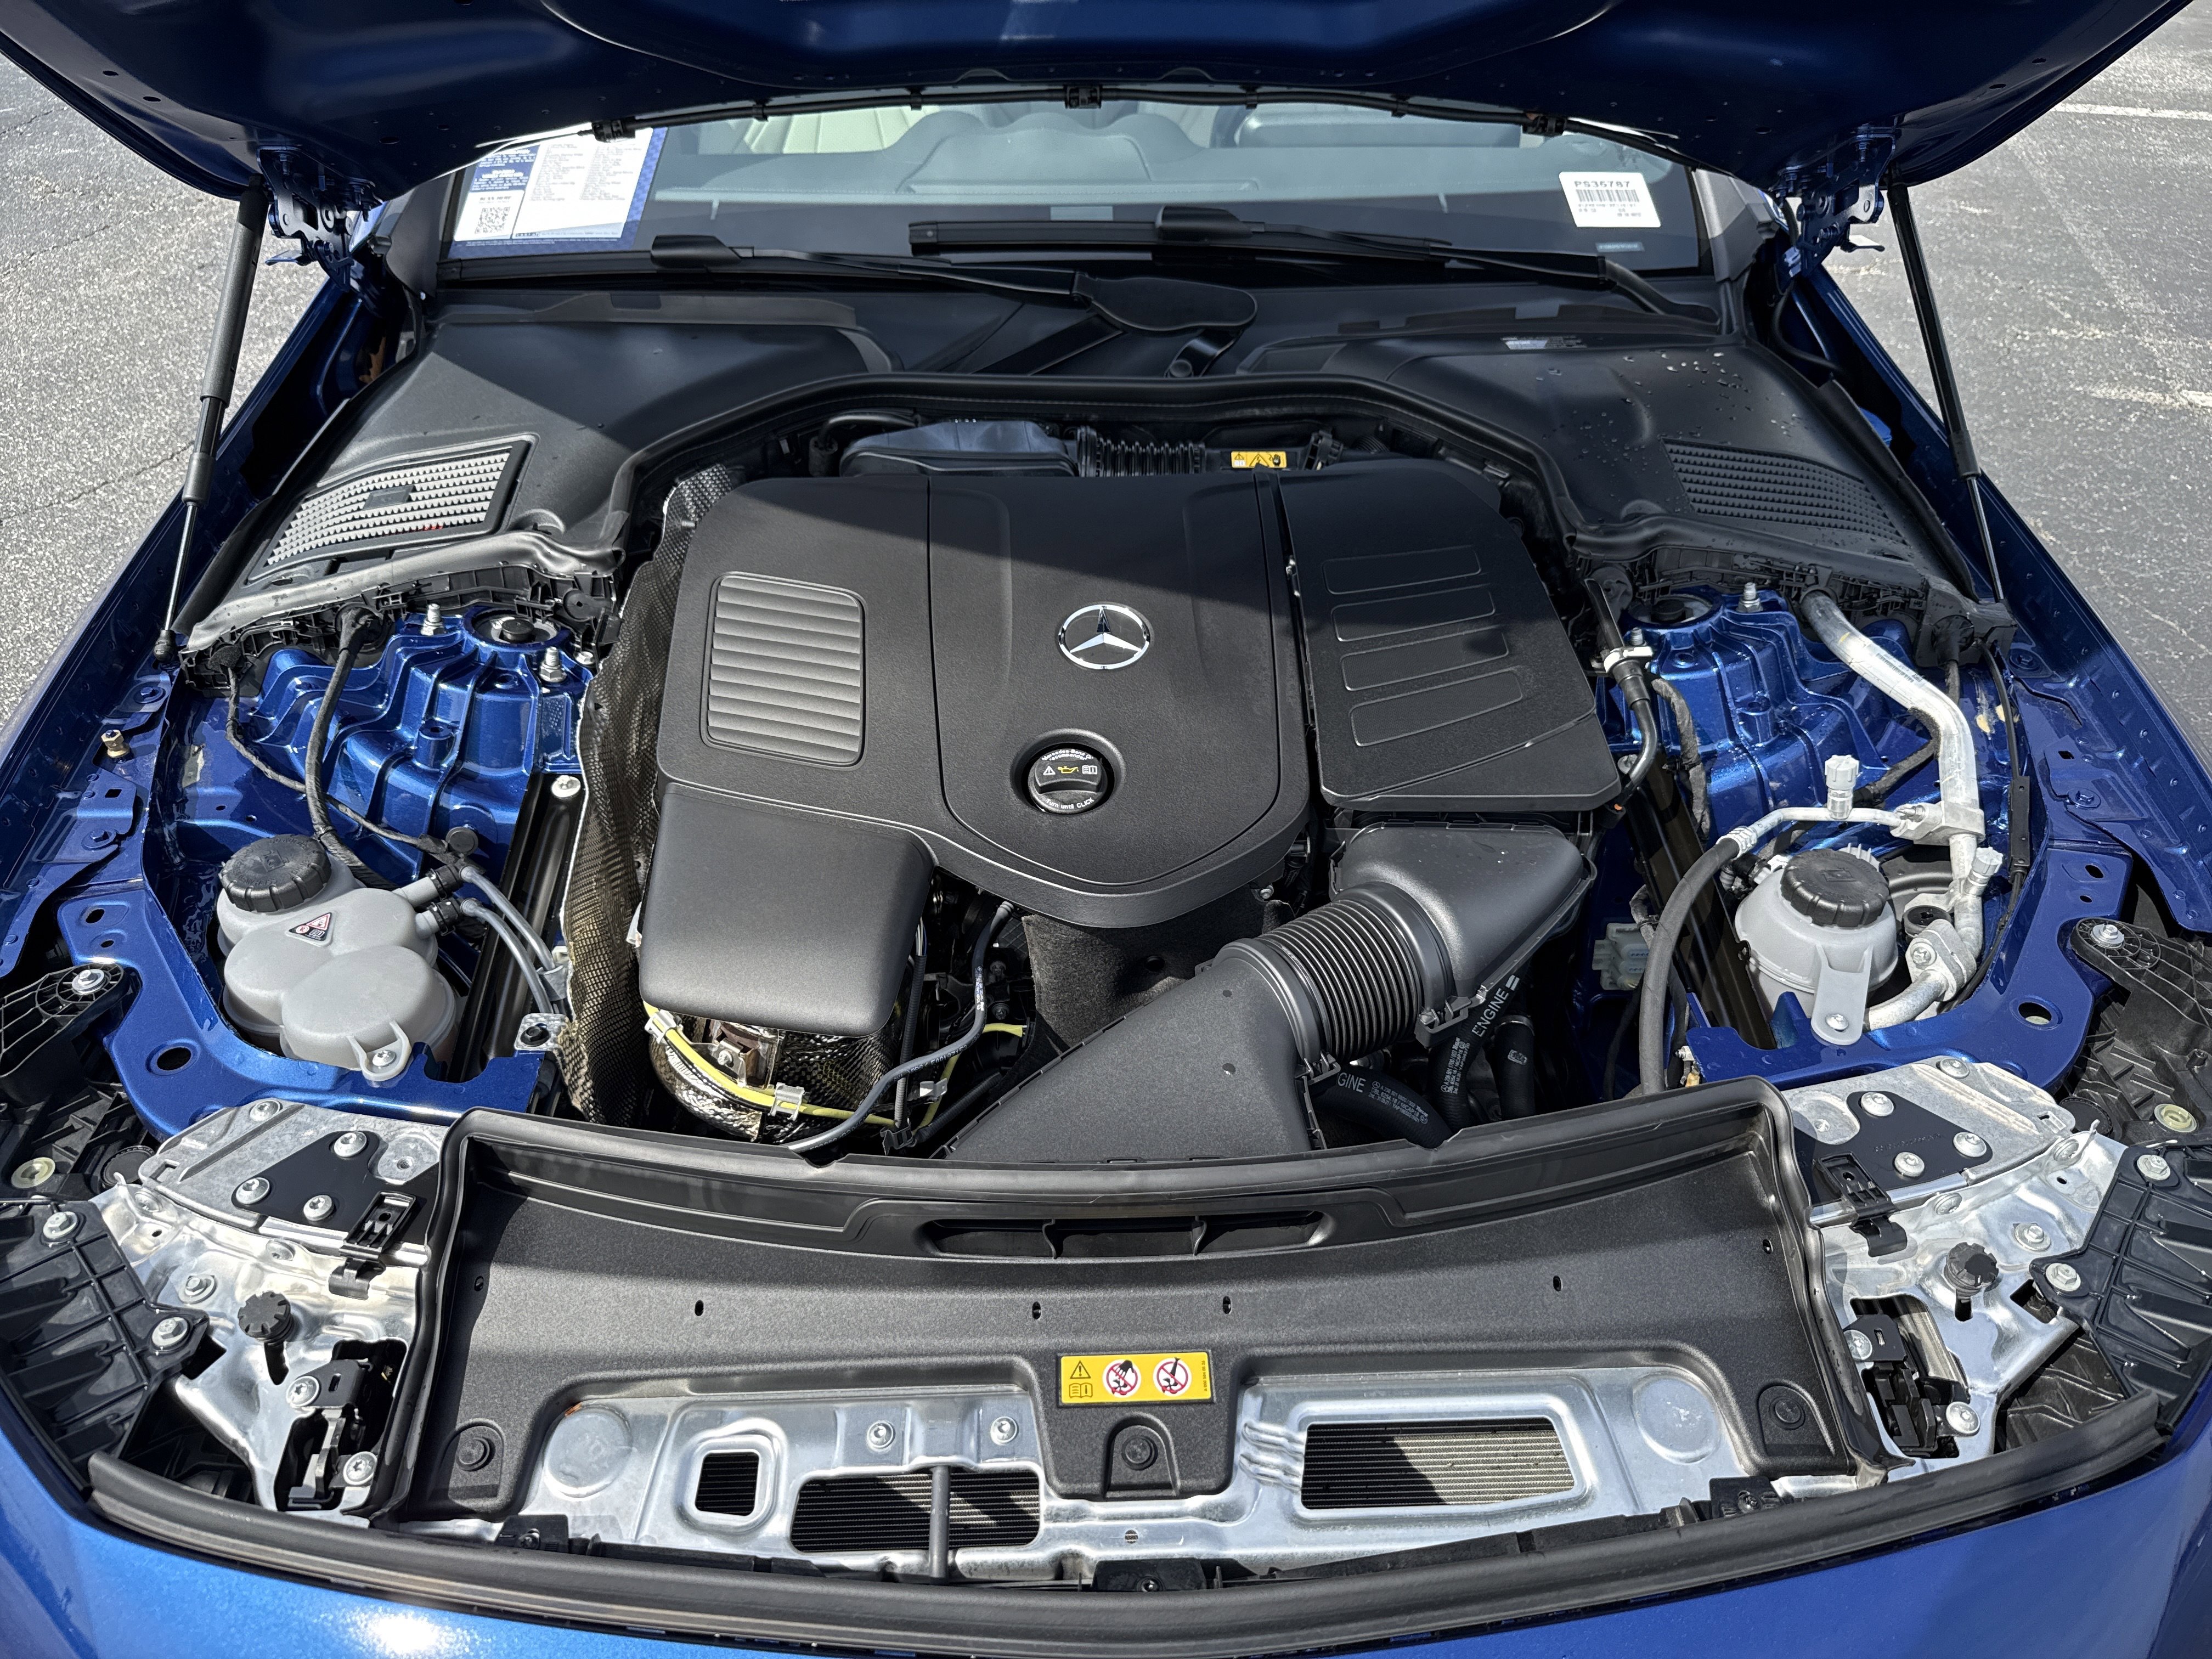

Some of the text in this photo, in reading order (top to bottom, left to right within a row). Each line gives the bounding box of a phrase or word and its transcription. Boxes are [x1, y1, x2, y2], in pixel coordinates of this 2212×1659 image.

[1041, 749, 1086, 760] Mercedes-Benz
[1046, 798, 1059, 808] Turn
[1076, 797, 1094, 808] CLICK
[1471, 988, 1509, 1037] ENGINE
